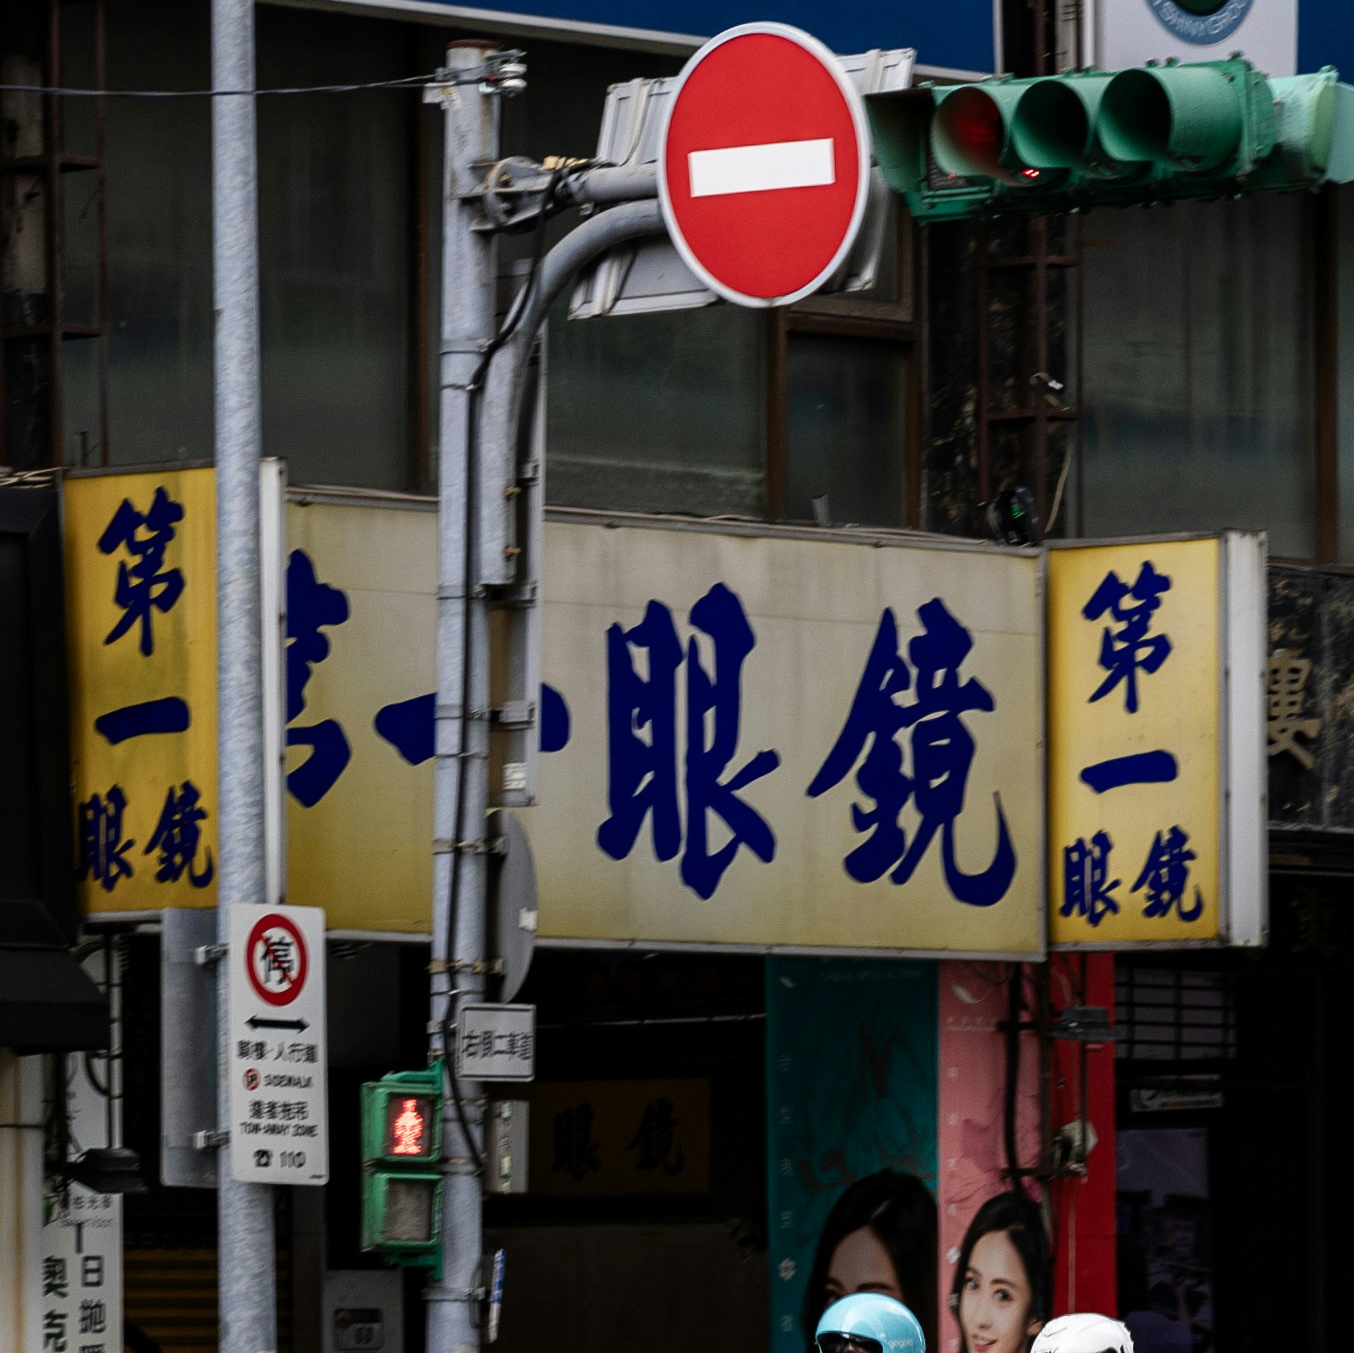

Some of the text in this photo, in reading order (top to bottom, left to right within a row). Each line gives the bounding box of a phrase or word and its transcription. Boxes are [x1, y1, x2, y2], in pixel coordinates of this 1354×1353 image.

[95, 486, 191, 745] 第一
[1078, 560, 1178, 793] 第一
[74, 780, 215, 893] 眼鏡
[1059, 825, 1203, 926] 眼鏡
[279, 1150, 307, 1169] 110
